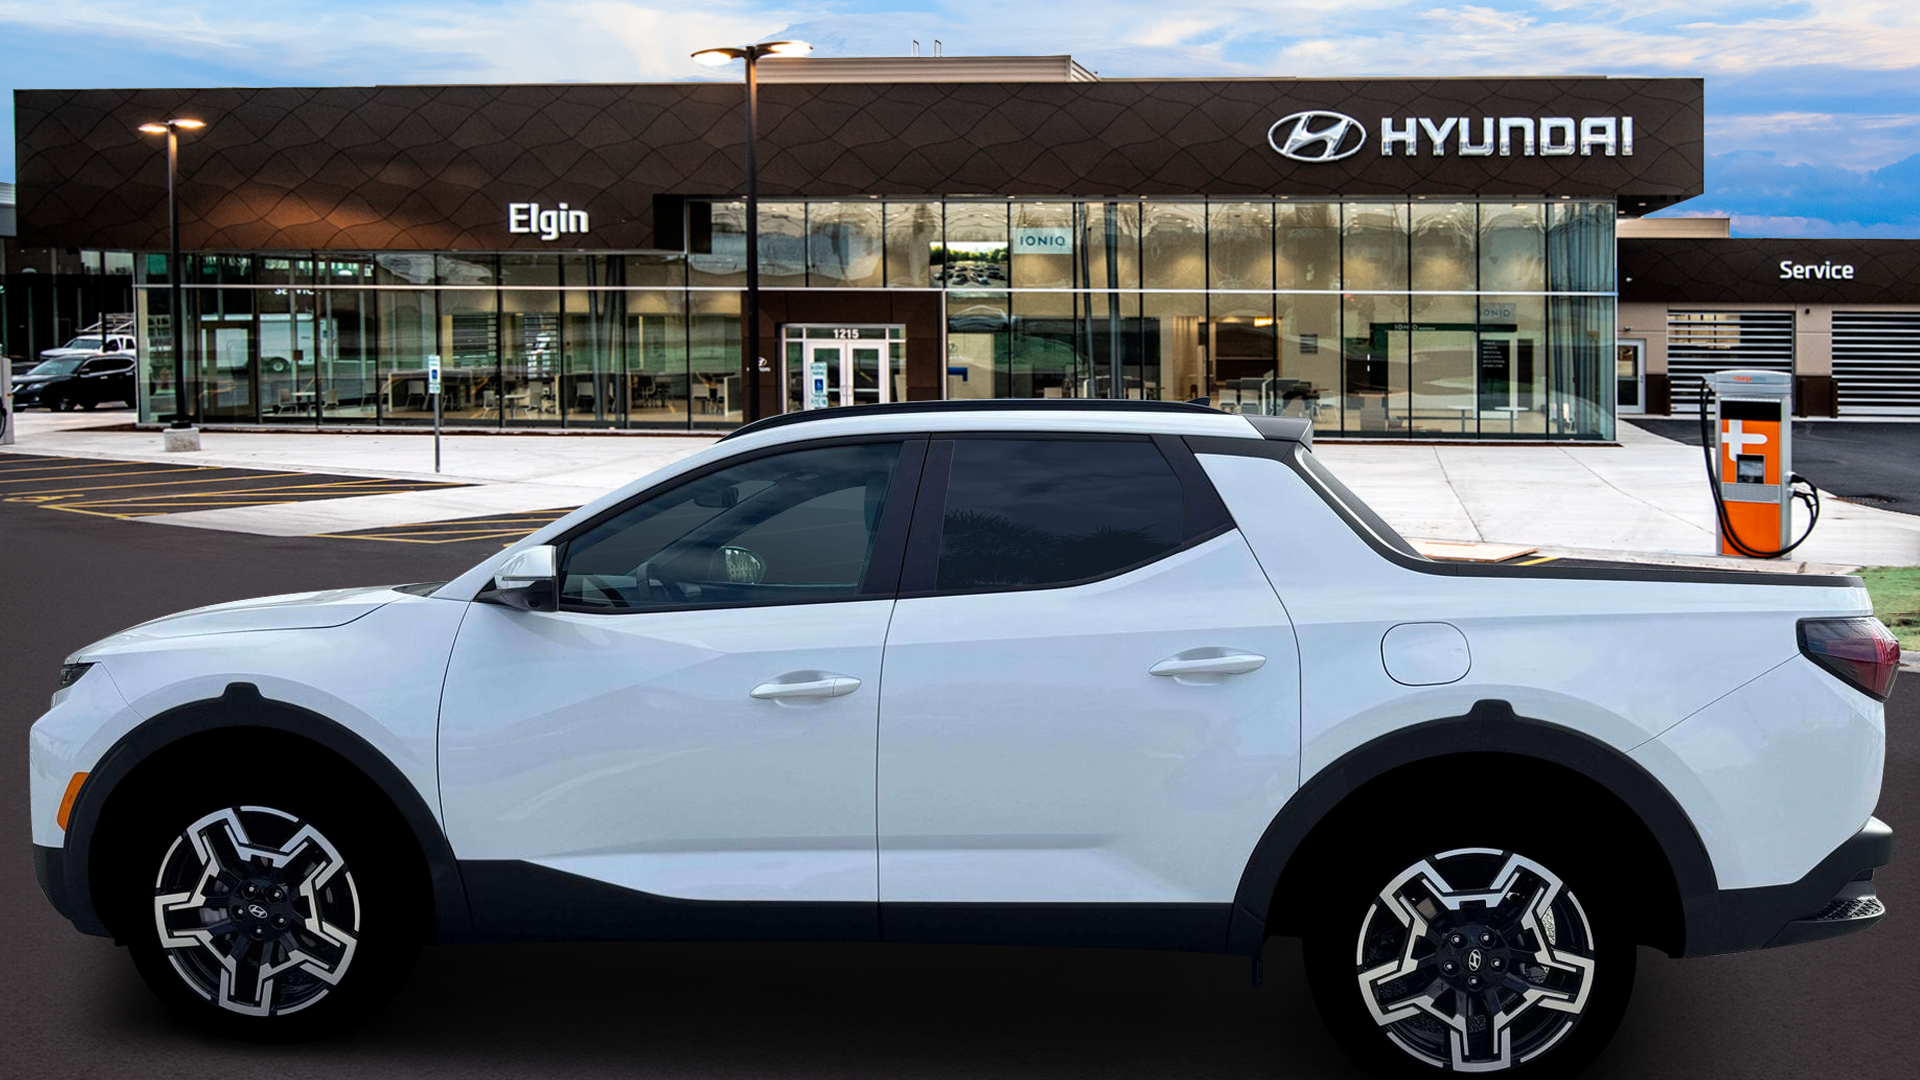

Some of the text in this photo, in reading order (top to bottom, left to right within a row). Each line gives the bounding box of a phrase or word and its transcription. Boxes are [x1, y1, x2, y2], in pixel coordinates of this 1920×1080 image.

[1381, 117, 1633, 156] HYUNDAI
[508, 203, 589, 240] Elgin
[1020, 236, 1066, 246] IONIQ
[1780, 261, 1854, 279] Service
[833, 328, 859, 339] 1215
